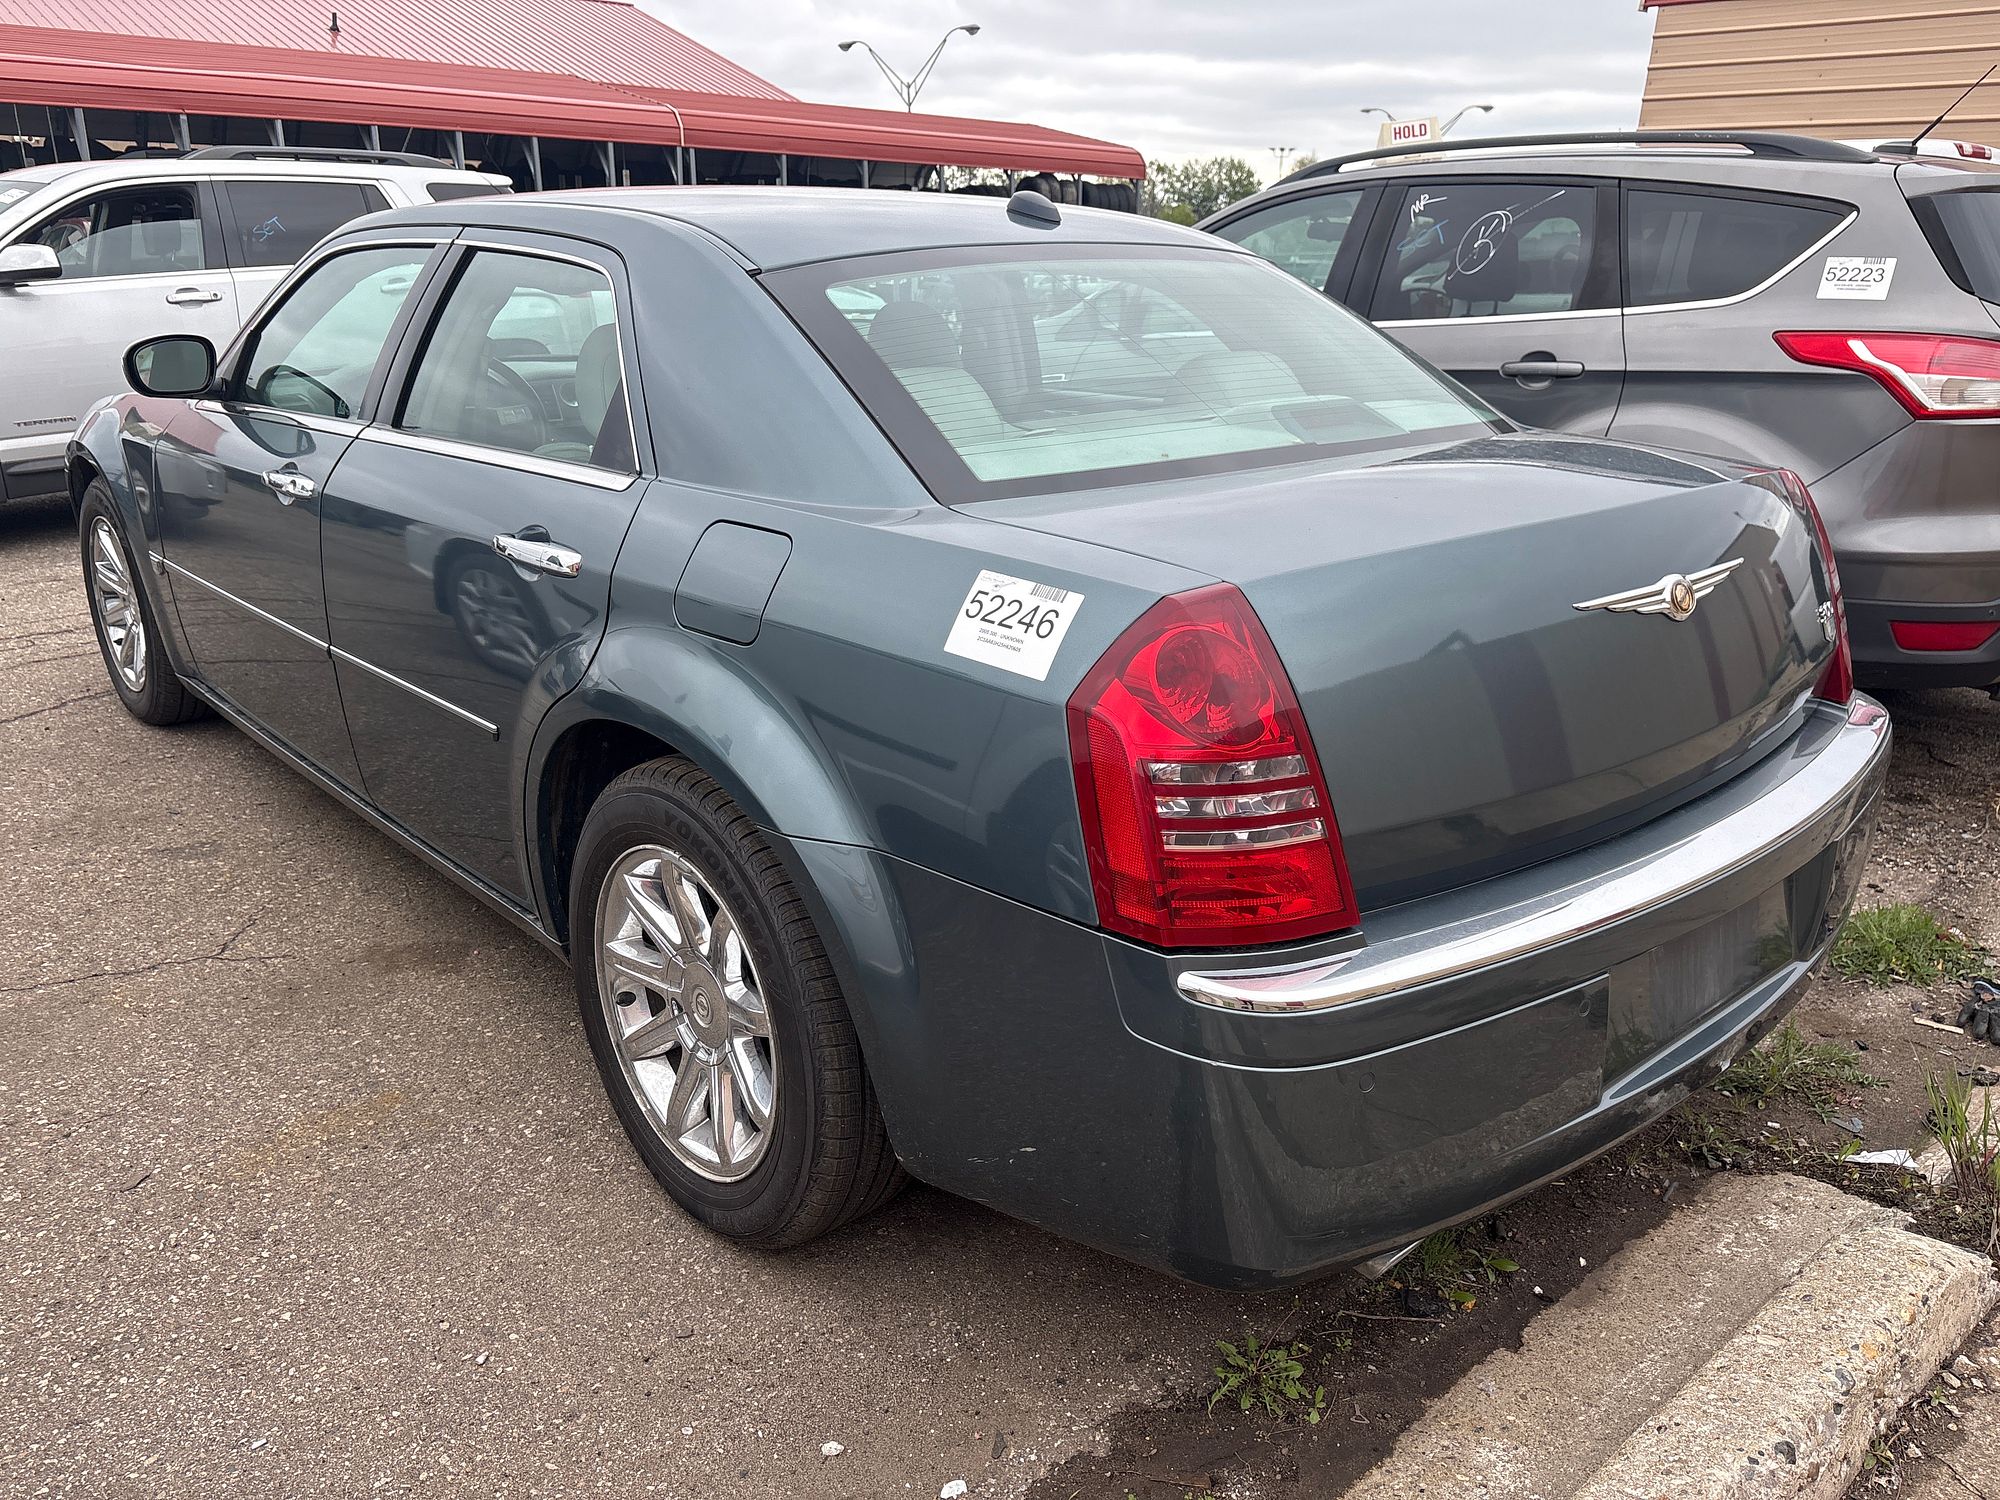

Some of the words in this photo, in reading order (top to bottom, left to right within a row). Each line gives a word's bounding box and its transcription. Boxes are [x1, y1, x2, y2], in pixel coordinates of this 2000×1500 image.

[1393, 123, 1427, 141] HOLD
[252, 216, 287, 242] SET
[1825, 266, 1885, 283] 52223
[13, 416, 77, 427] TERRAIN
[965, 590, 1060, 639] 52246
[662, 809, 774, 968] YOKOHAMA
